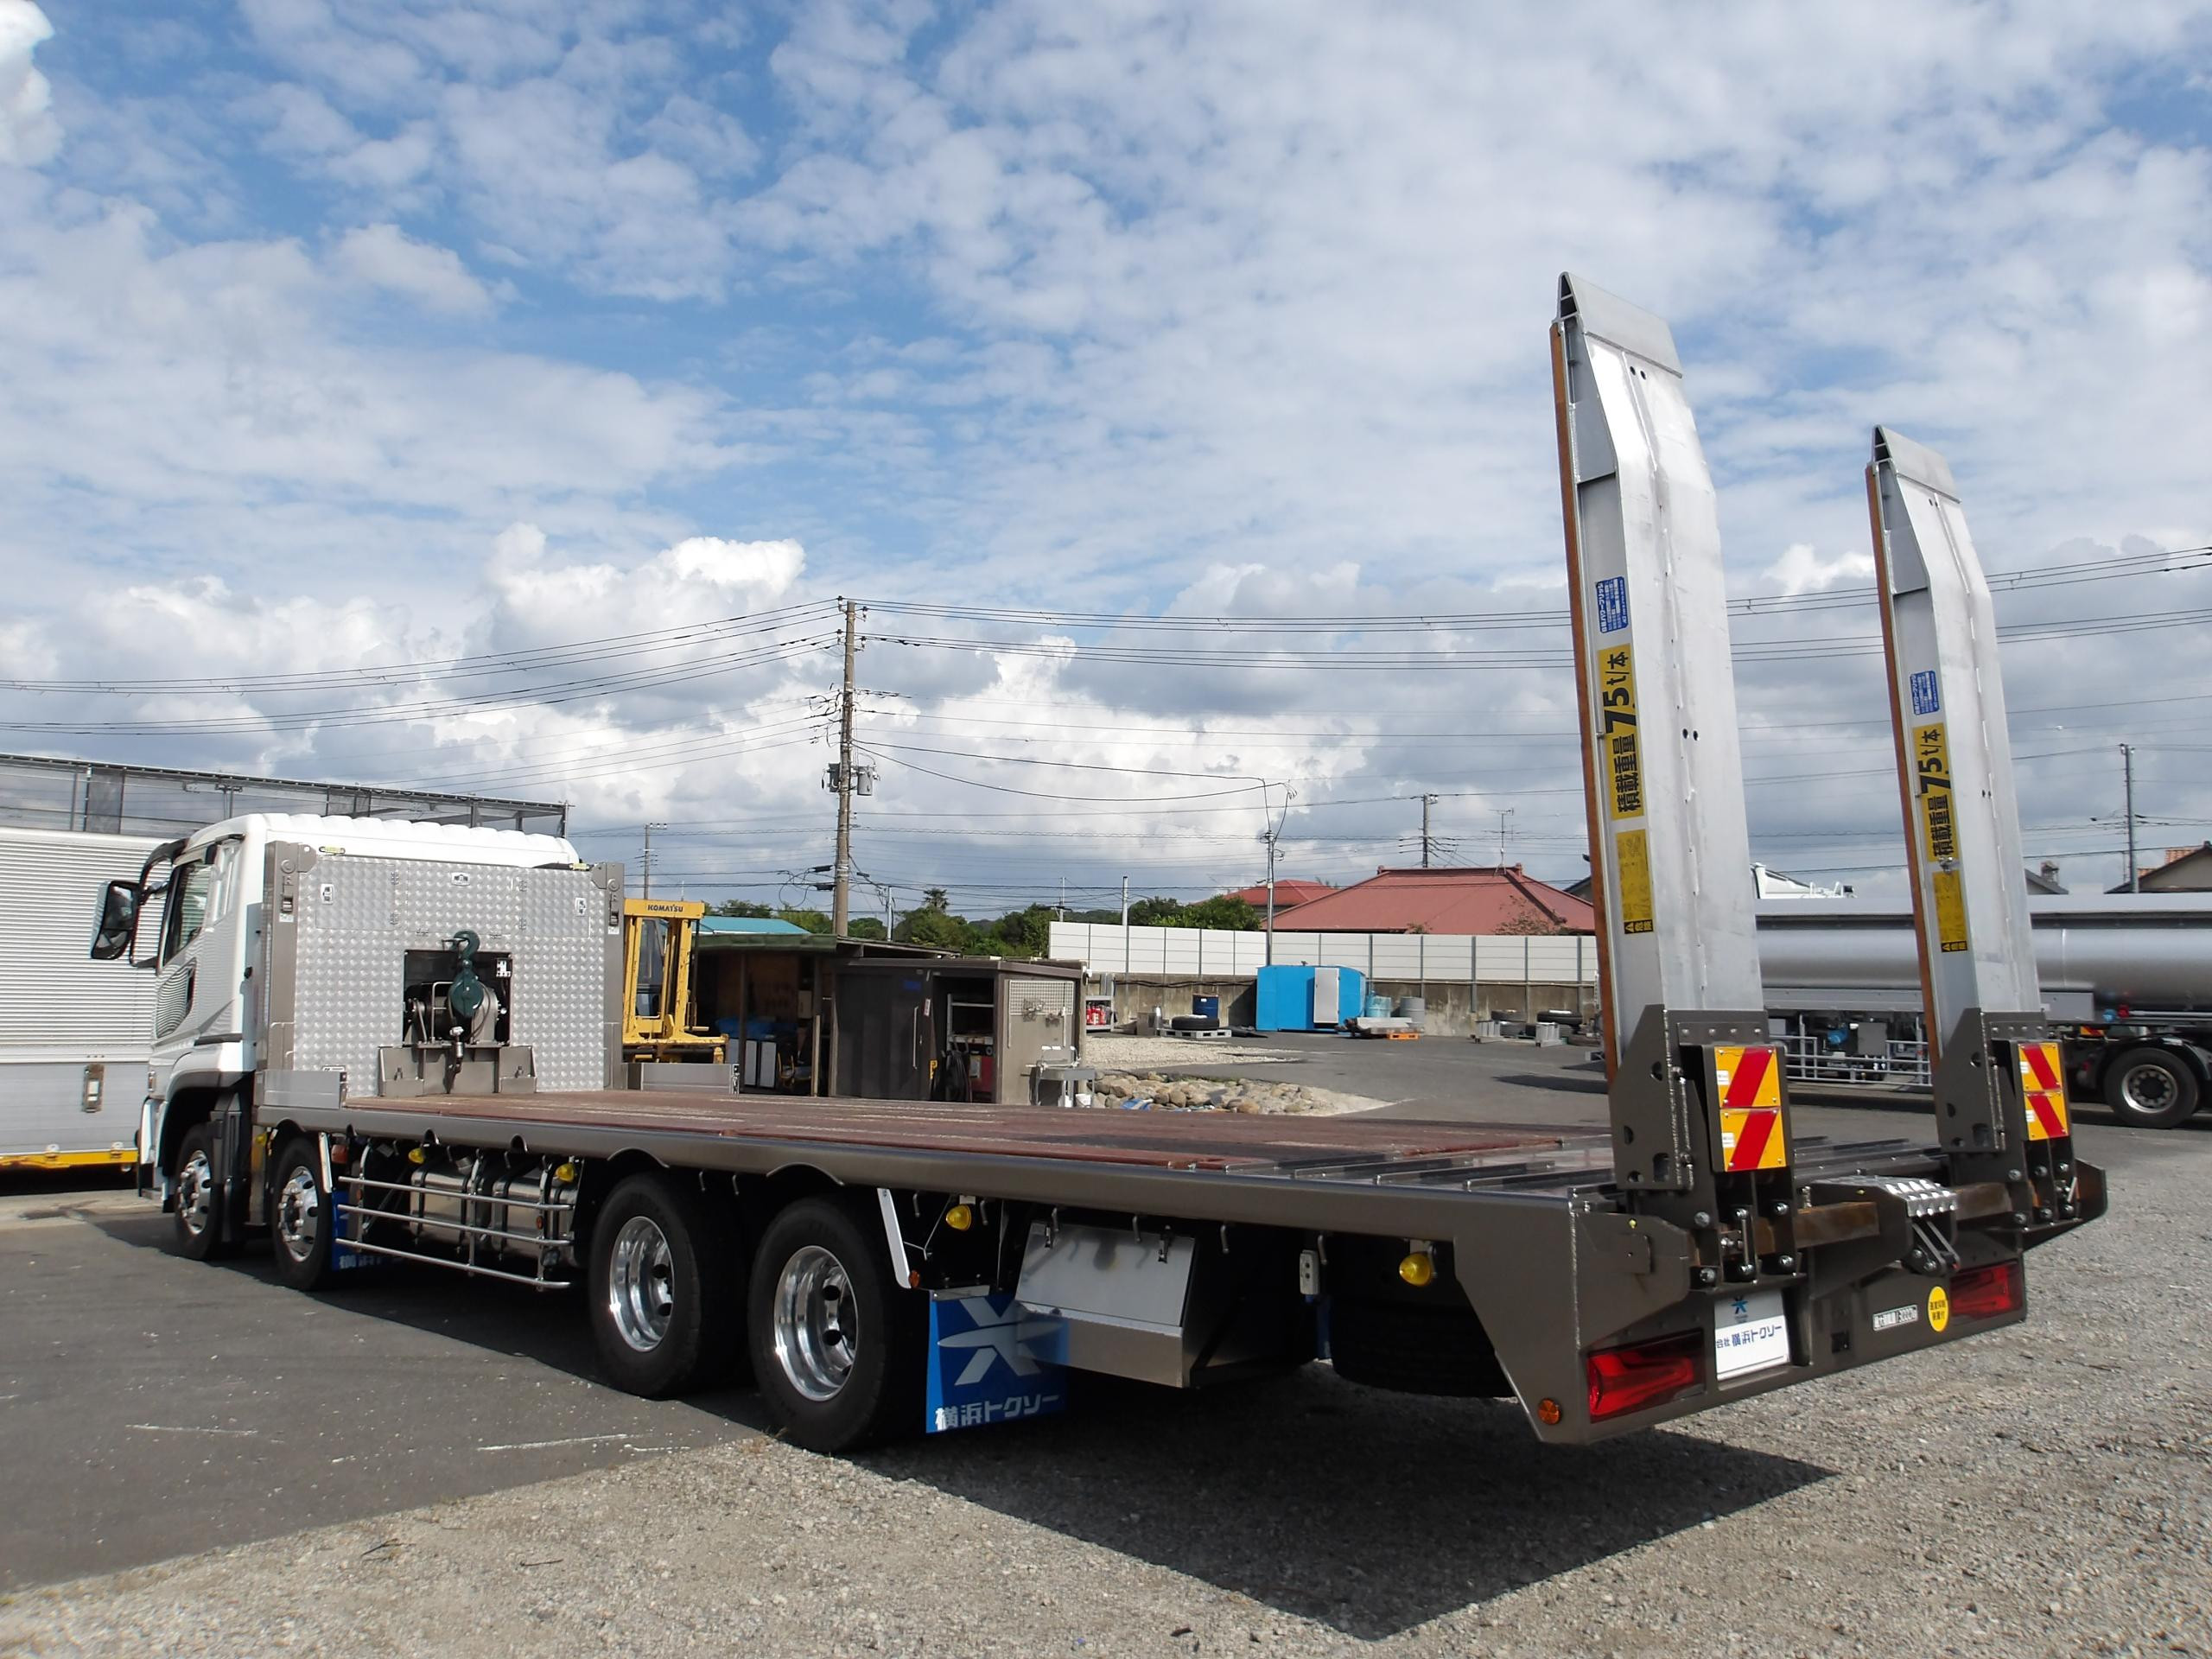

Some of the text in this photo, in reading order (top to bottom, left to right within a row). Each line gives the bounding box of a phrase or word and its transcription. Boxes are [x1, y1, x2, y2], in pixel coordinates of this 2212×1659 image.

[647, 904, 683, 912] KOMATSU
[935, 1394, 1060, 1431] 横浜トクソー
